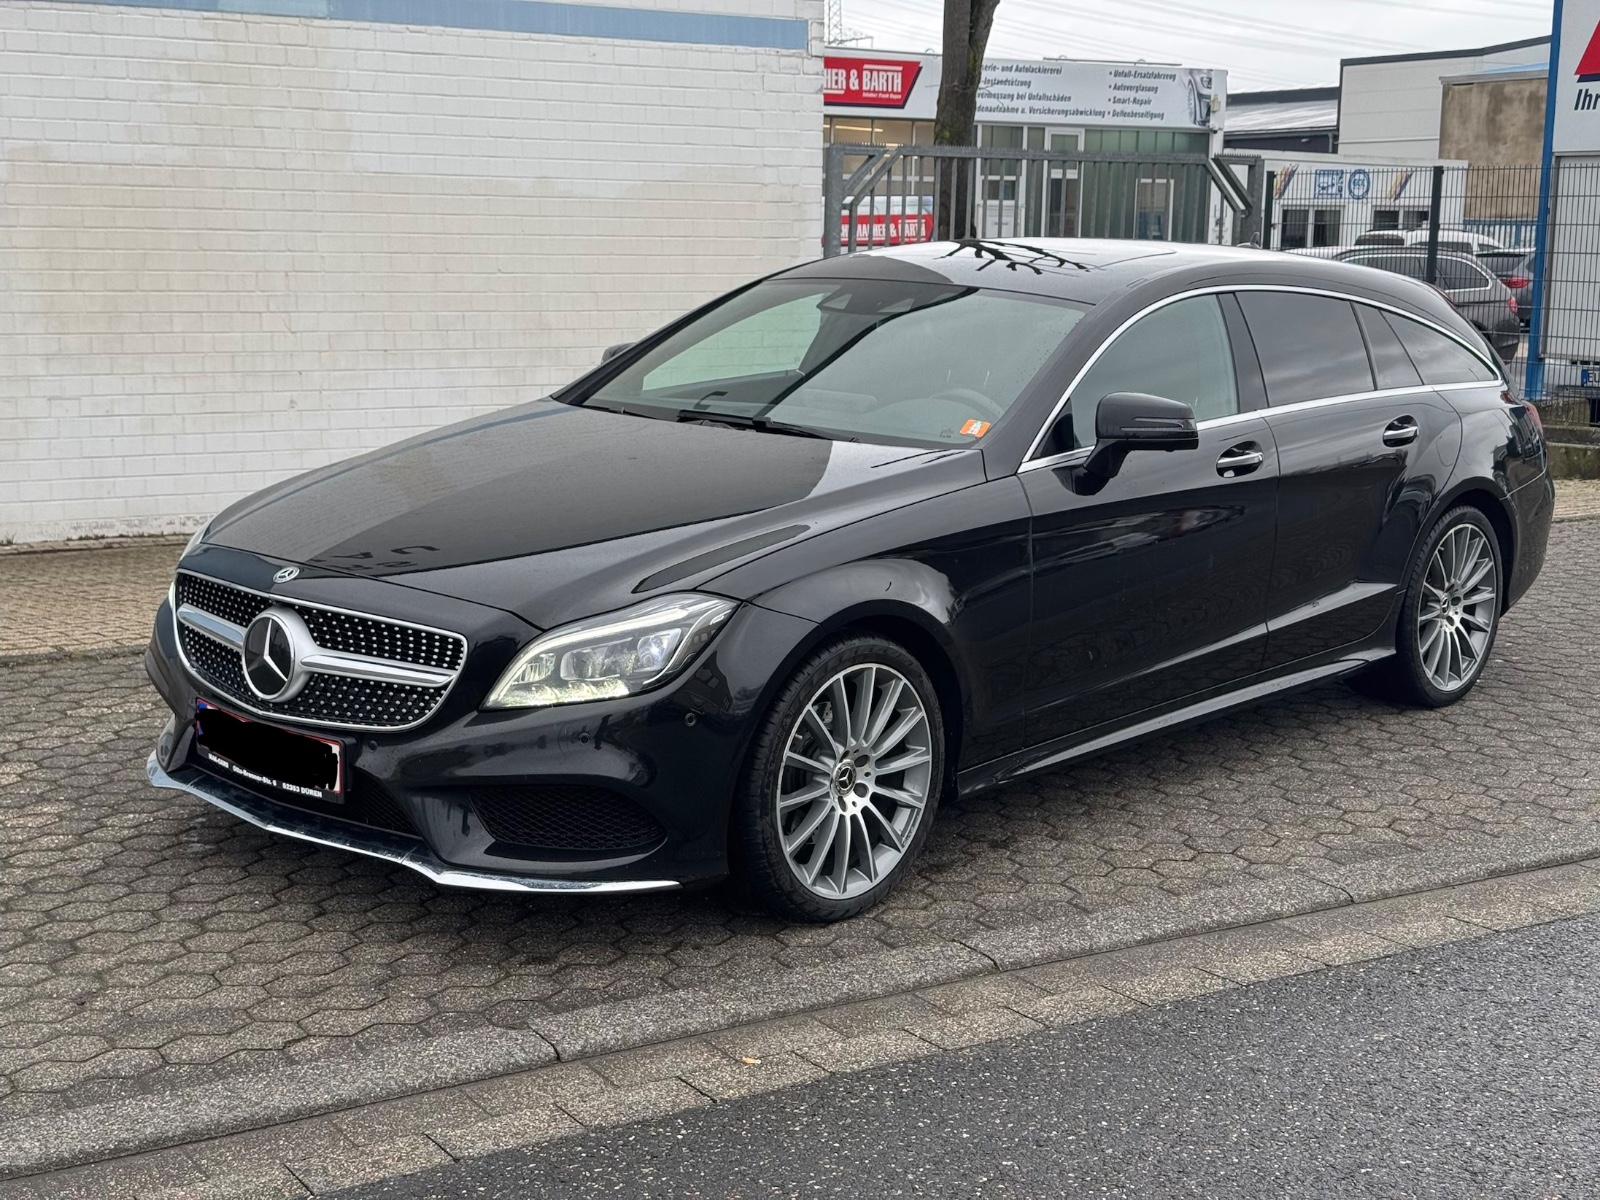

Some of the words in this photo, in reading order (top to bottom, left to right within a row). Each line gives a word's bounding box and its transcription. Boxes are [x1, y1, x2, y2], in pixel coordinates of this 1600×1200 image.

[1014, 64, 1062, 75] Autolackiererei
[849, 68, 859, 91] &
[862, 70, 902, 92] BARTH
[1113, 70, 1177, 82] Unfall-Ersatzfahrzeug
[1112, 83, 1159, 94] Autoverglasung
[1016, 92, 1027, 100] bei
[1028, 92, 1072, 102] Unfallschäden
[1112, 95, 1152, 106] Smart-Repair
[1028, 106, 1106, 118] Versicherungsabwicklung
[1112, 109, 1165, 120] Dellenbeseitigung
[301, 786, 323, 798] DÜREN
